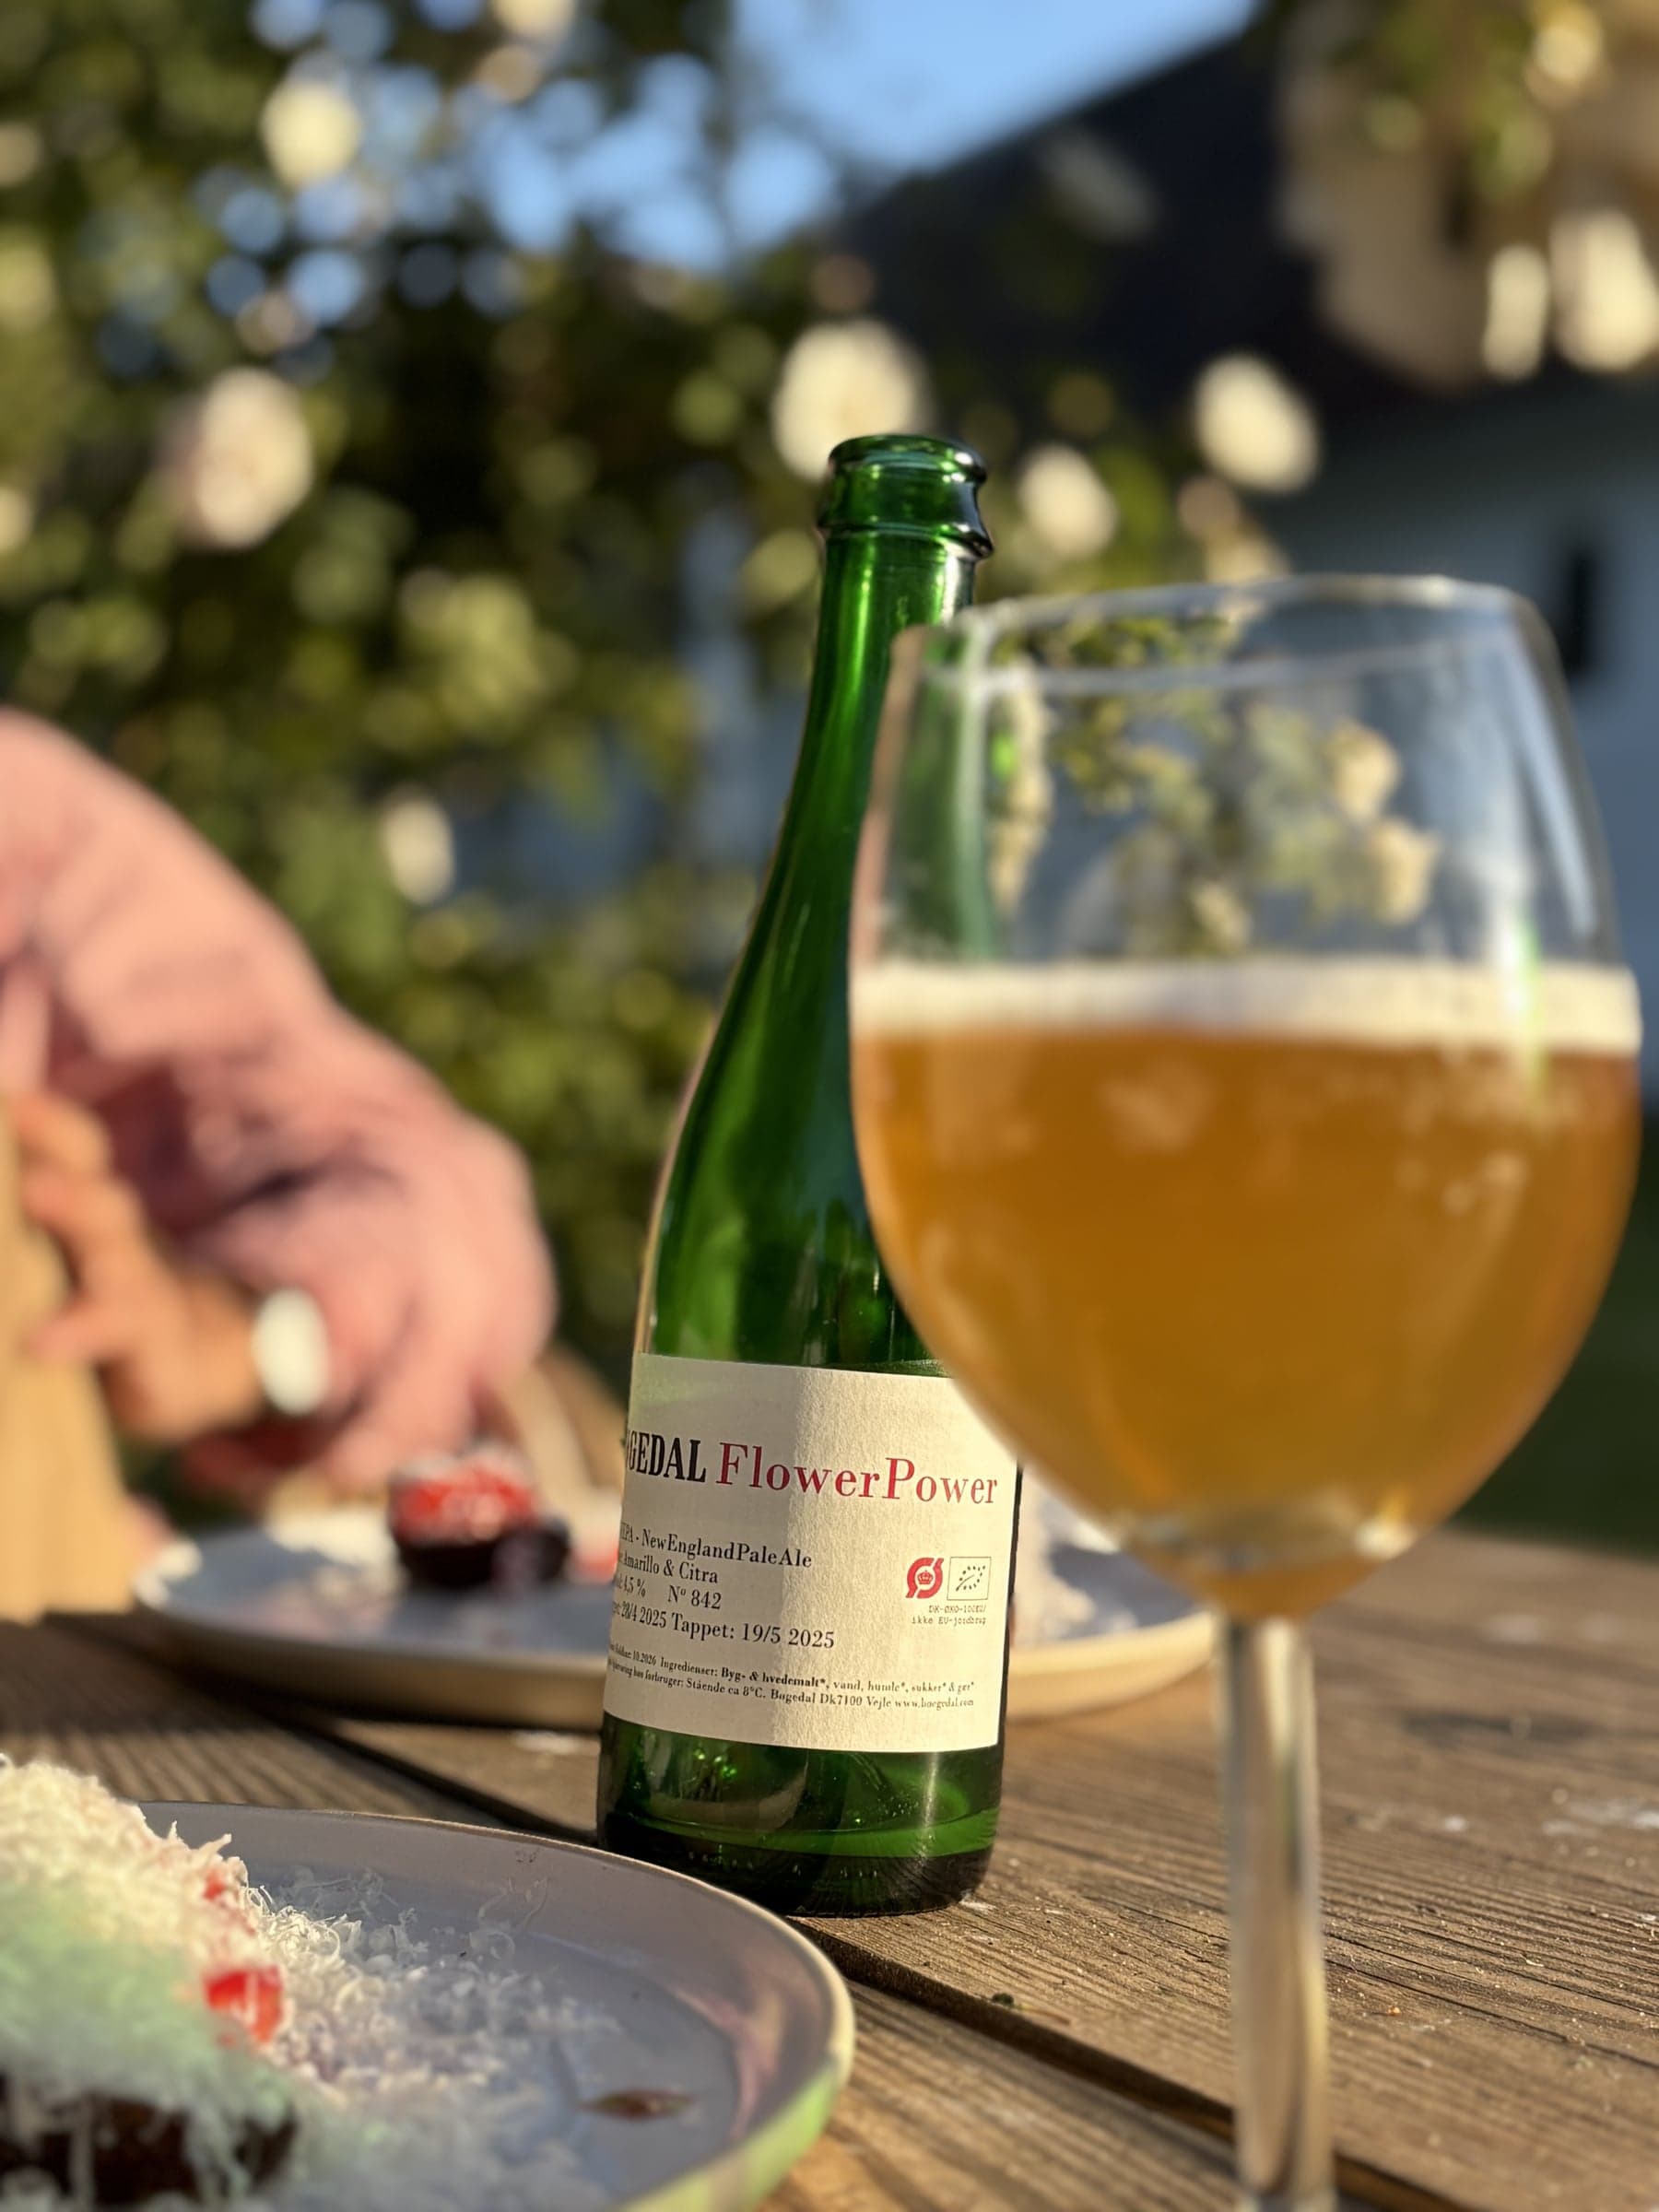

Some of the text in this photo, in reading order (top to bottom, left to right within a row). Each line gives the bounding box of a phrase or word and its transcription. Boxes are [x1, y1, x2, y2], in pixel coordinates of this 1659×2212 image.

[626, 1430, 998, 1504] GEDAL FlowerPower
[641, 1528, 812, 1568] NewEnglandPaleAle
[664, 1559, 675, 1577] &
[679, 1561, 718, 1583] Citra
[690, 1589, 722, 1609] 842
[640, 1606, 666, 1629] 2025
[671, 1612, 735, 1641] Tappet:
[742, 1623, 781, 1643] 19/5
[788, 1628, 835, 1649] 2025
[661, 1657, 718, 1677] Ingredienser:
[749, 1671, 759, 1682] &
[833, 1679, 864, 1692] vand,
[686, 1677, 725, 1694] Stående
[728, 1688, 739, 1696] ca
[866, 1695, 891, 1710] Vejle
